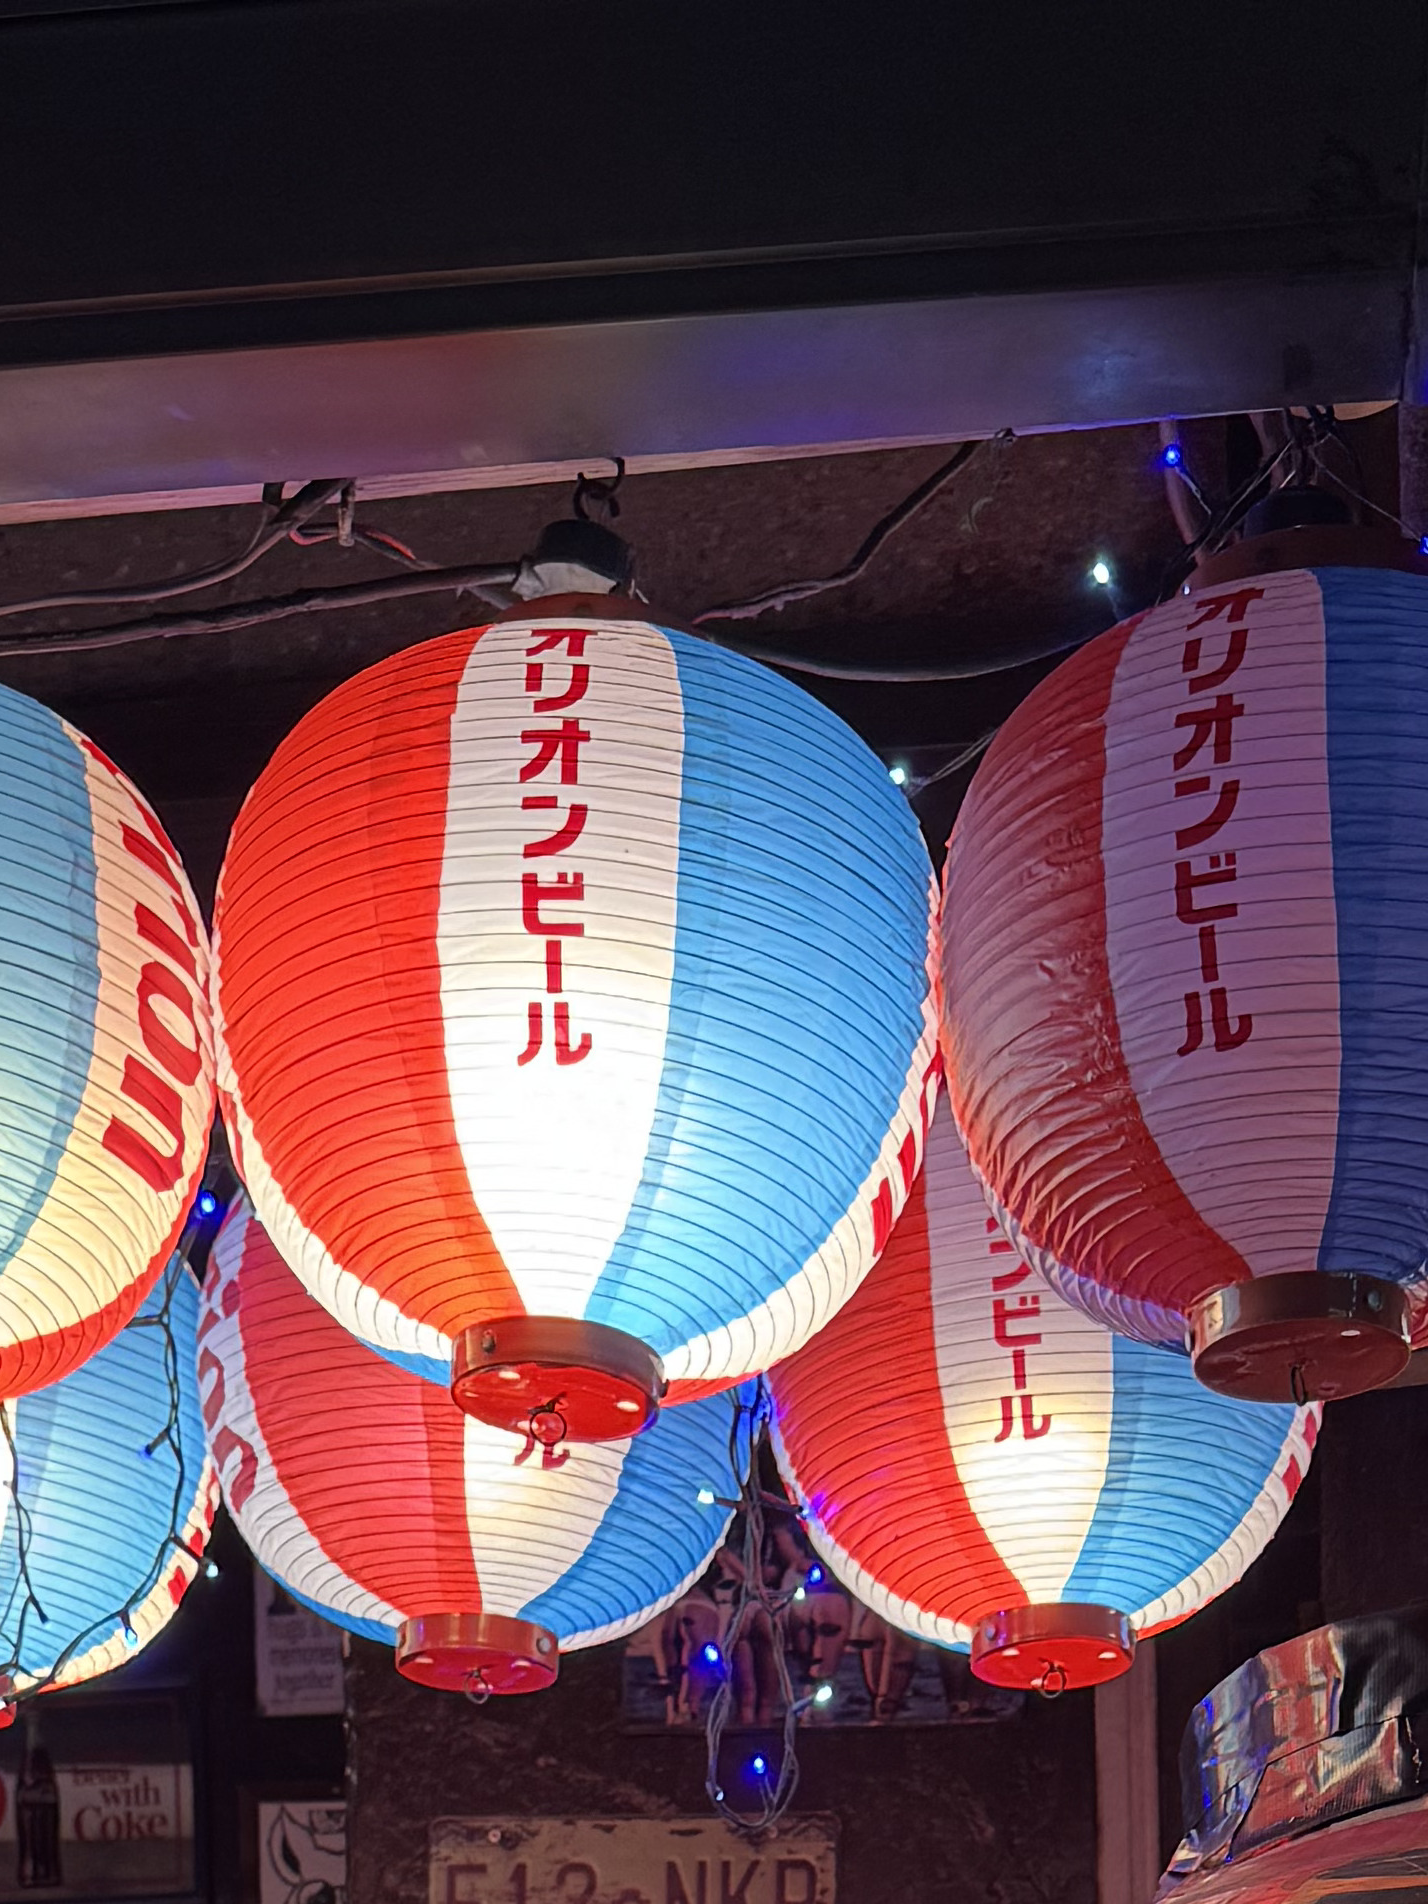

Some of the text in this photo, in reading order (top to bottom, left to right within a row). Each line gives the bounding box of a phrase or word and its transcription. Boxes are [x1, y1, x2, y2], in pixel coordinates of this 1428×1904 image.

[517, 628, 599, 1066] オリオンビール
[1174, 588, 1265, 1057] オリオンビール
[74, 1806, 168, 1845] Coke
[100, 1776, 162, 1807] with
